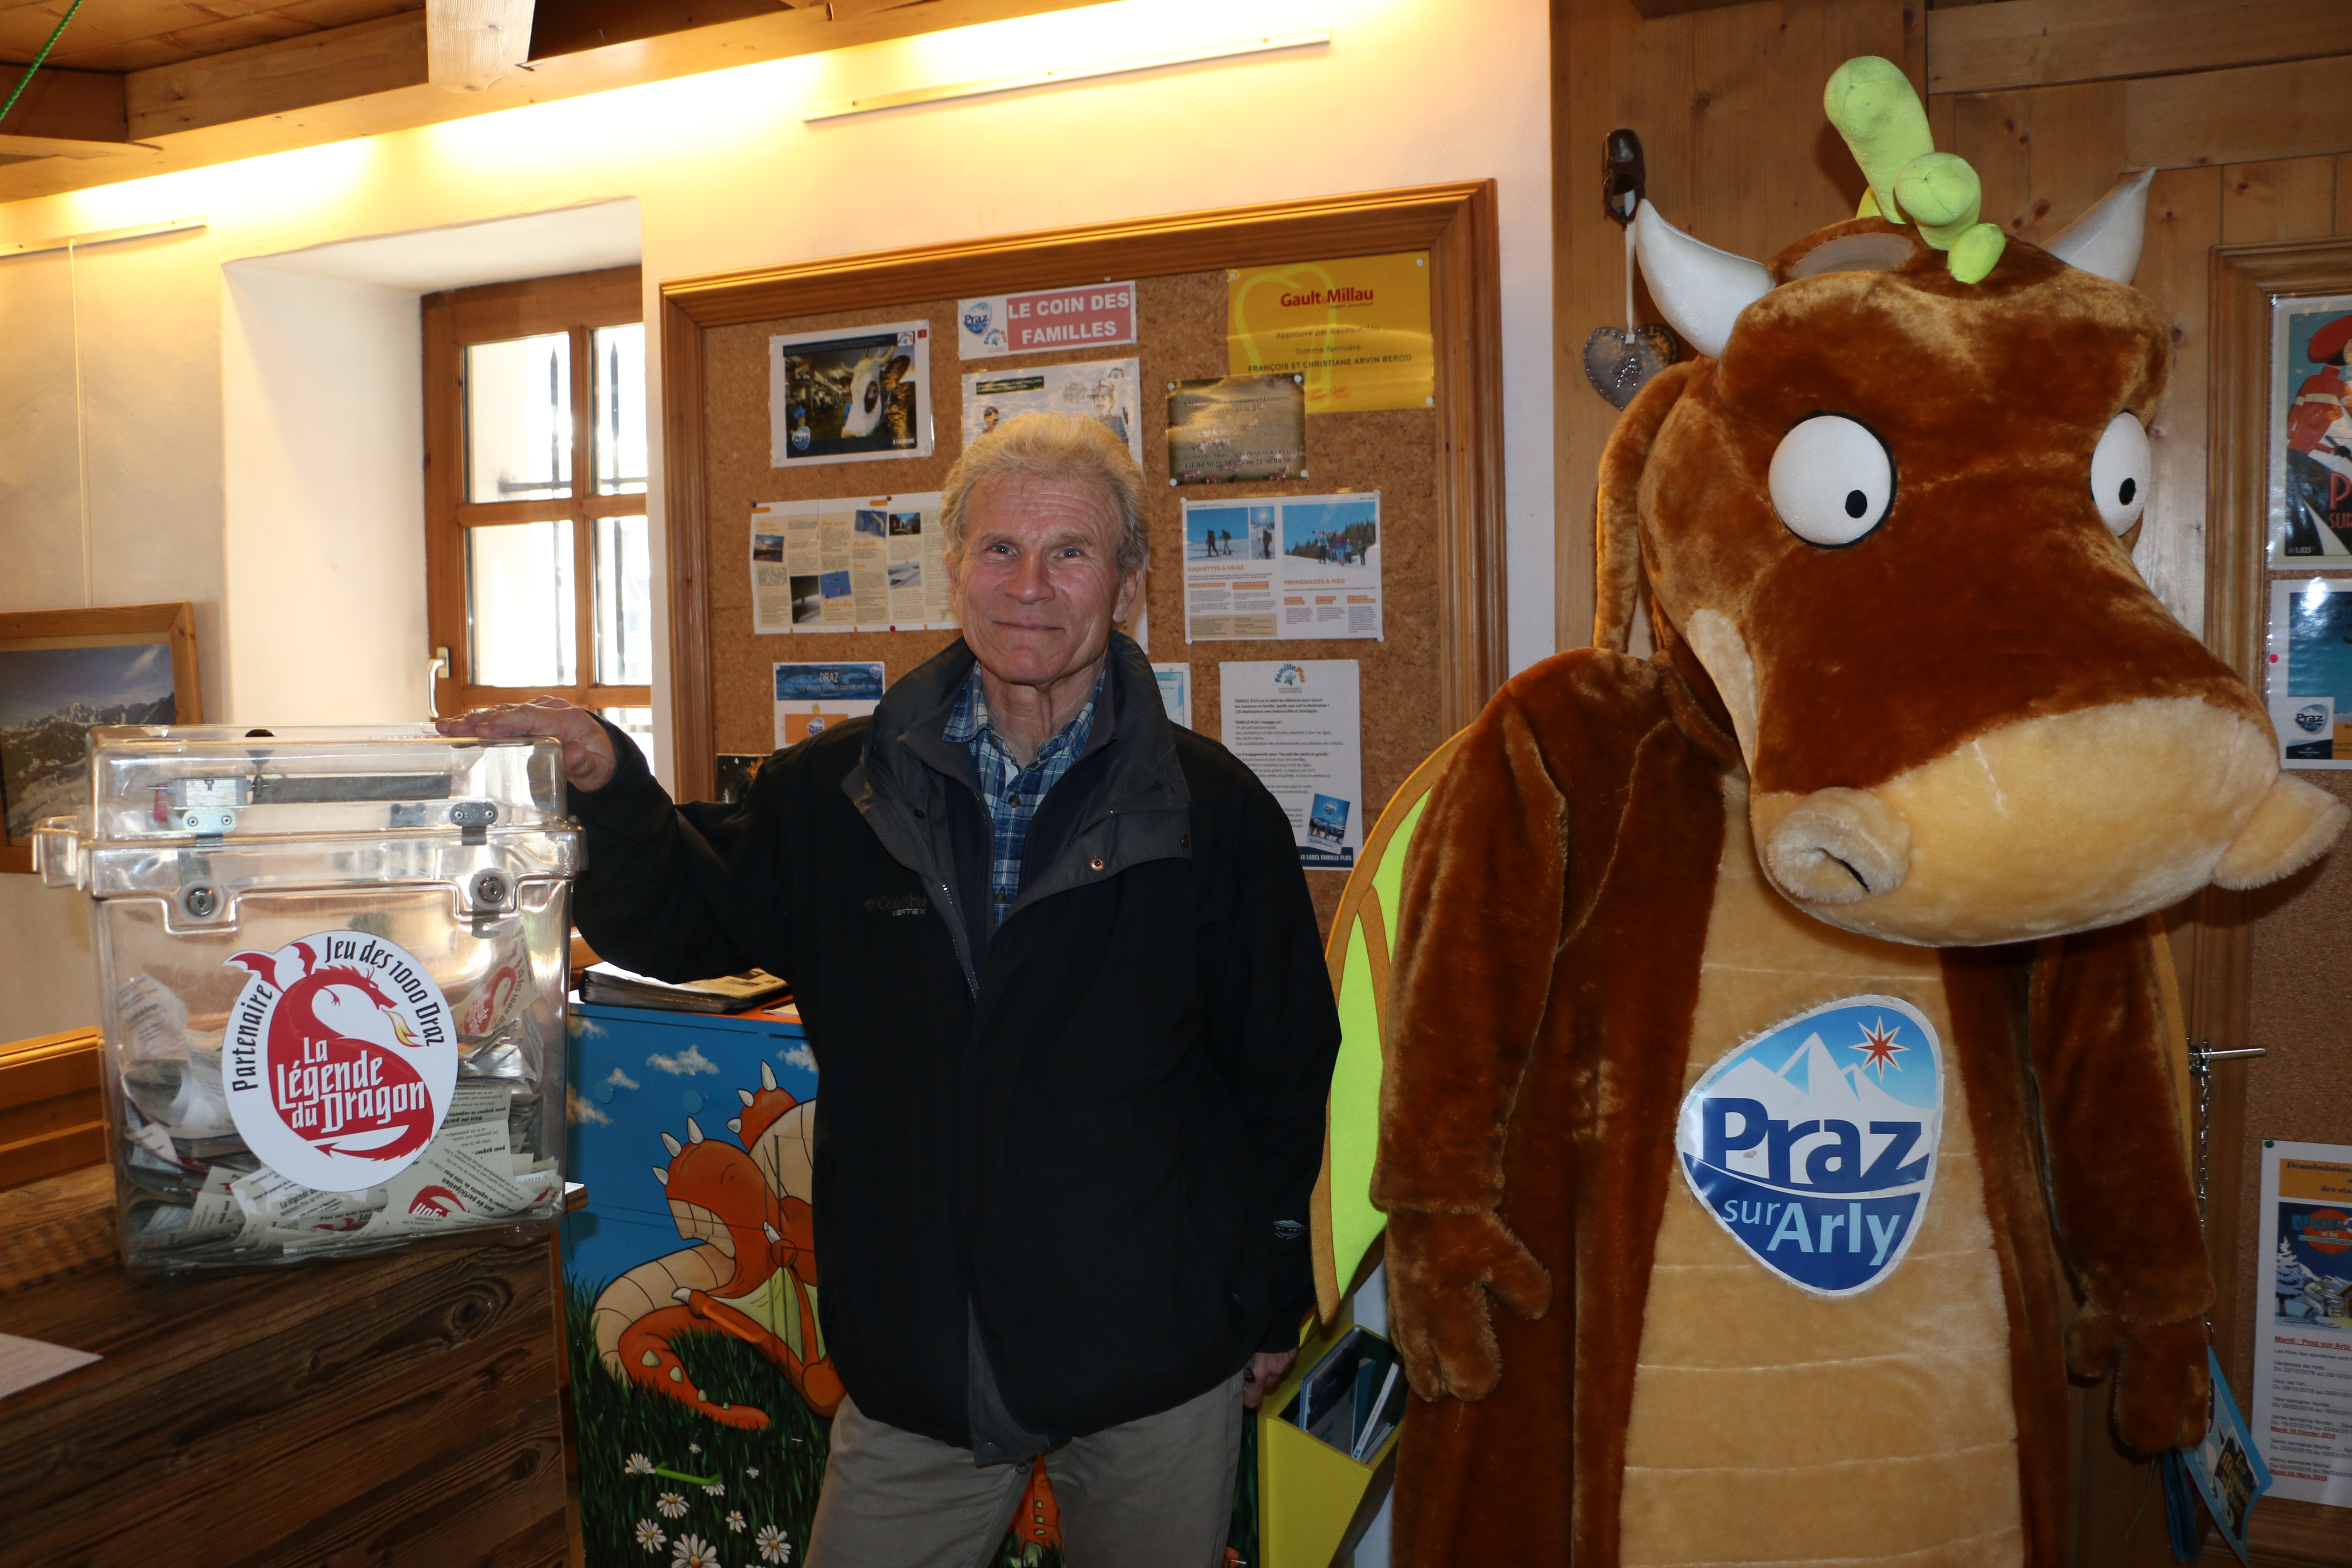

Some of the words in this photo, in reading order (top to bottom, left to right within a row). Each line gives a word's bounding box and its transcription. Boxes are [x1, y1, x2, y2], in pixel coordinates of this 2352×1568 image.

[1008, 303, 1031, 319] LE
[1036, 297, 1084, 316] COIN
[1091, 292, 1130, 311] DES
[964, 314, 988, 325] Praz
[1022, 321, 1117, 344] FAMILLES
[1276, 330, 1313, 340] Approuvé
[1327, 344, 1361, 353] fermière
[1248, 363, 1289, 373] FRANÇOIS
[1303, 359, 1351, 369] CHRISTIANE
[820, 672, 838, 682] DRAZ
[1275, 664, 1296, 682] Famille
[2296, 713, 2323, 722] Praz
[878, 894, 926, 909] Columbia
[232, 984, 273, 1091] Partenaire
[325, 937, 356, 962] Jeu
[359, 940, 392, 968] des
[388, 961, 428, 1004] 1000
[415, 1002, 444, 1046] Draz
[303, 1037, 328, 1064] La
[277, 1050, 383, 1110] Légende
[292, 1102, 318, 1129] du
[320, 1081, 425, 1133] Dragon
[1702, 1097, 1929, 1194] Praz
[444, 1169, 455, 1178] Draz
[453, 1175, 465, 1185] 1000
[440, 1177, 478, 1203] participation
[469, 1185, 490, 1200] cagnotte
[475, 1199, 484, 1207] de
[493, 1199, 508, 1211] gagner
[1721, 1199, 1780, 1226] sur
[1766, 1202, 1900, 1266] Arly
